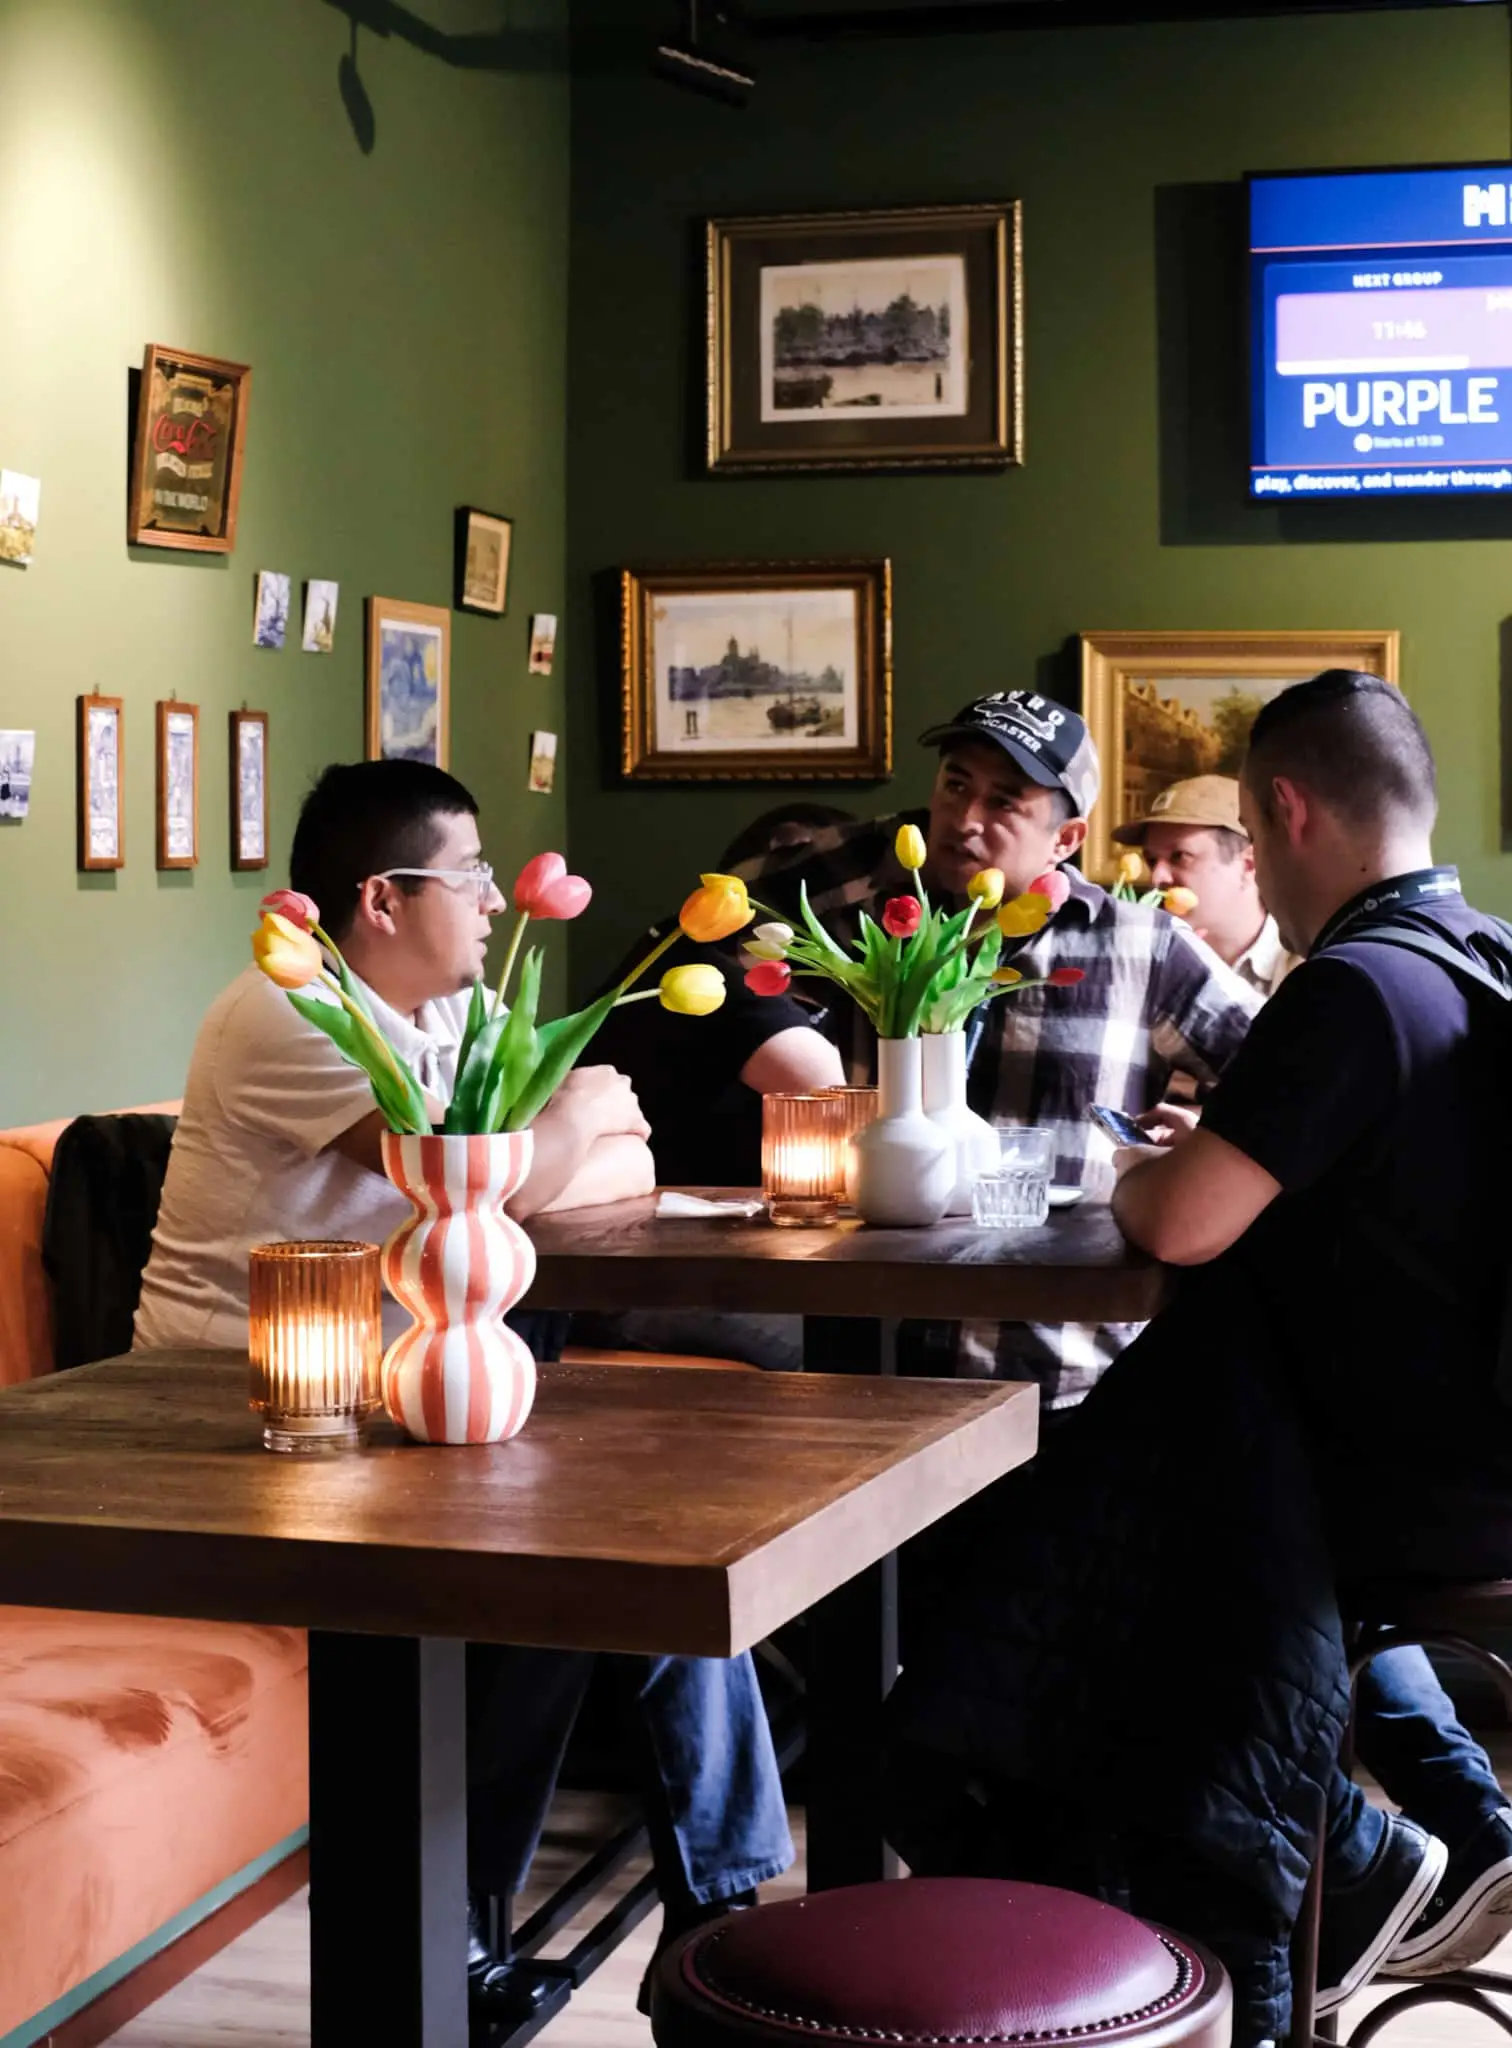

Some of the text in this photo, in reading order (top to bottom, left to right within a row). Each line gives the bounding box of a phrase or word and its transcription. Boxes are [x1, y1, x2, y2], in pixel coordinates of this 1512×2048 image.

[1353, 271, 1443, 288] NEXT GROUP
[1303, 377, 1499, 428] PURPLE
[1363, 472, 1392, 488] and
